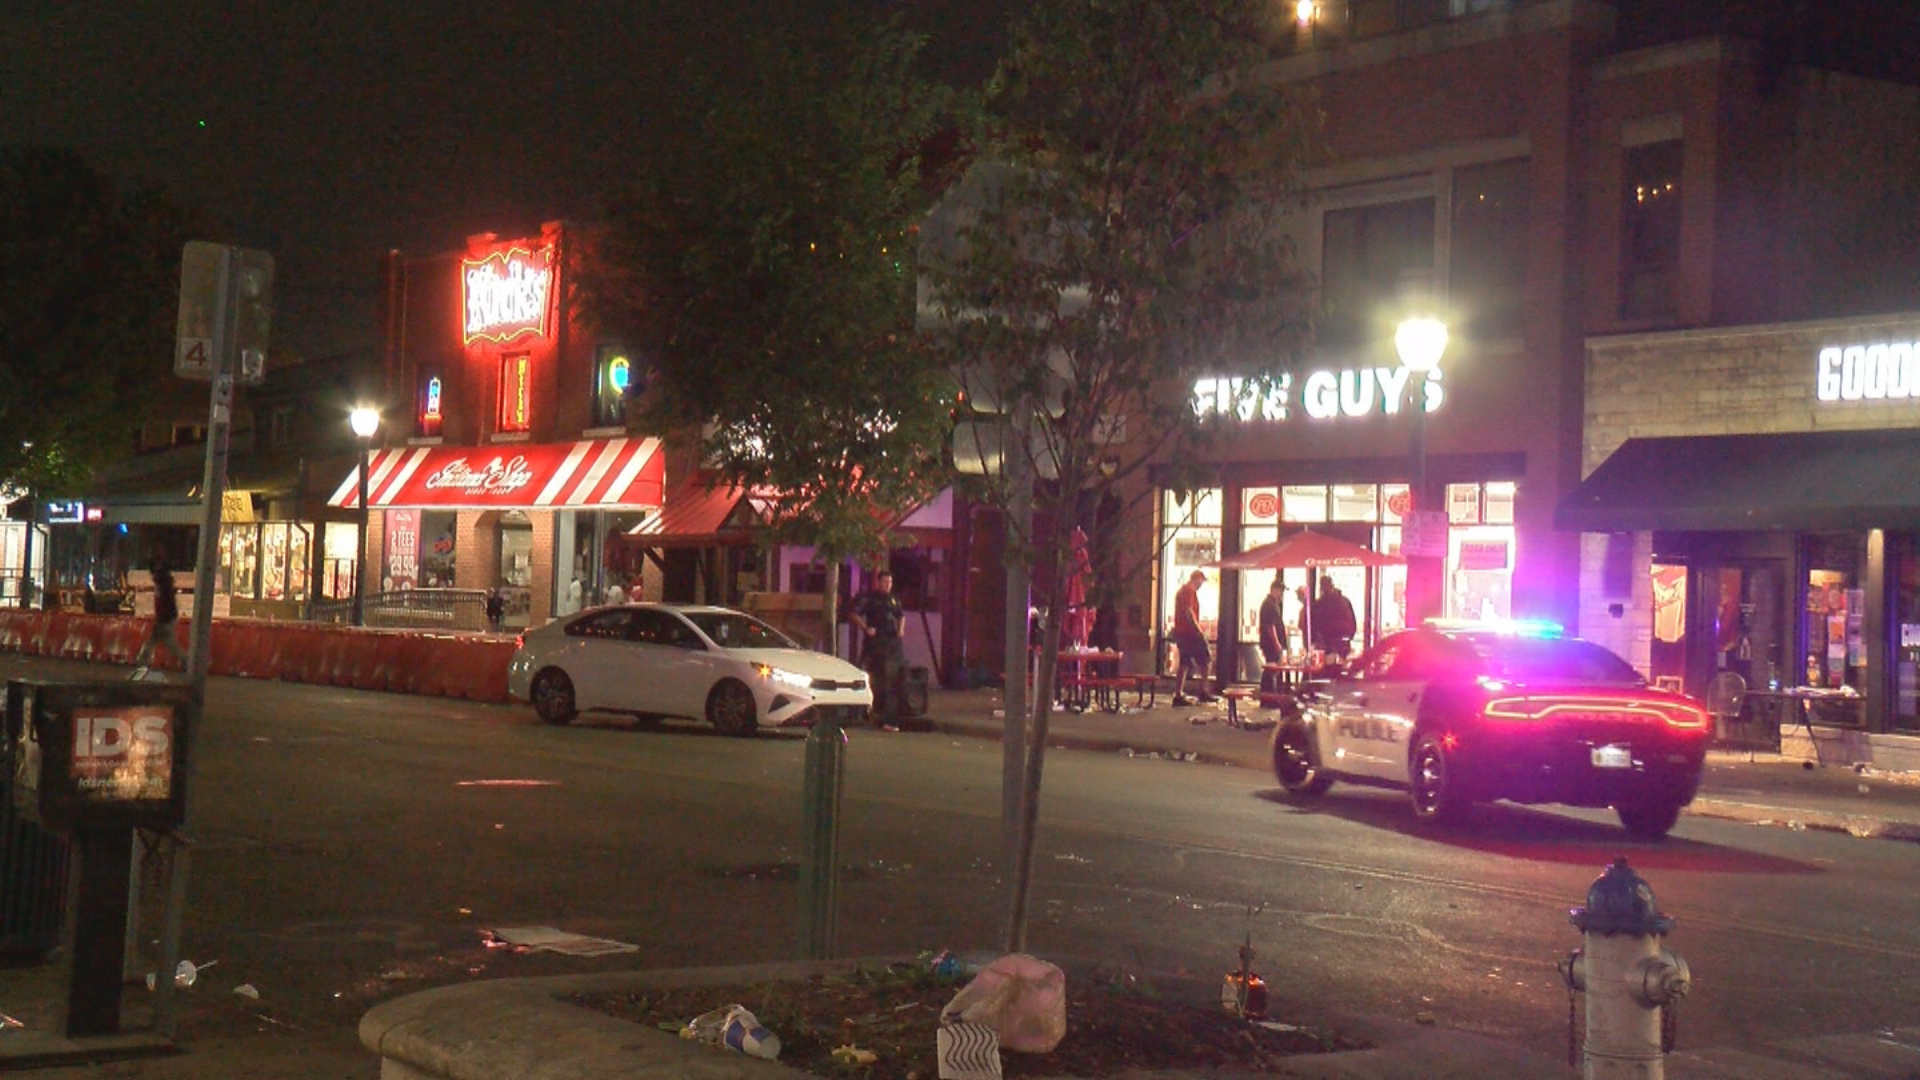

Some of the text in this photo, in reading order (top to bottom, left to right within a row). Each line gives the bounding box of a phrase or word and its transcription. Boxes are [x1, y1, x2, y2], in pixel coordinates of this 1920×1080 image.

[186, 341, 206, 366] 4
[1189, 364, 1444, 424] FIVE GUYS
[1251, 498, 1277, 513] OPEN
[75, 715, 169, 757] IDS
[1340, 719, 1399, 743] POLICE
